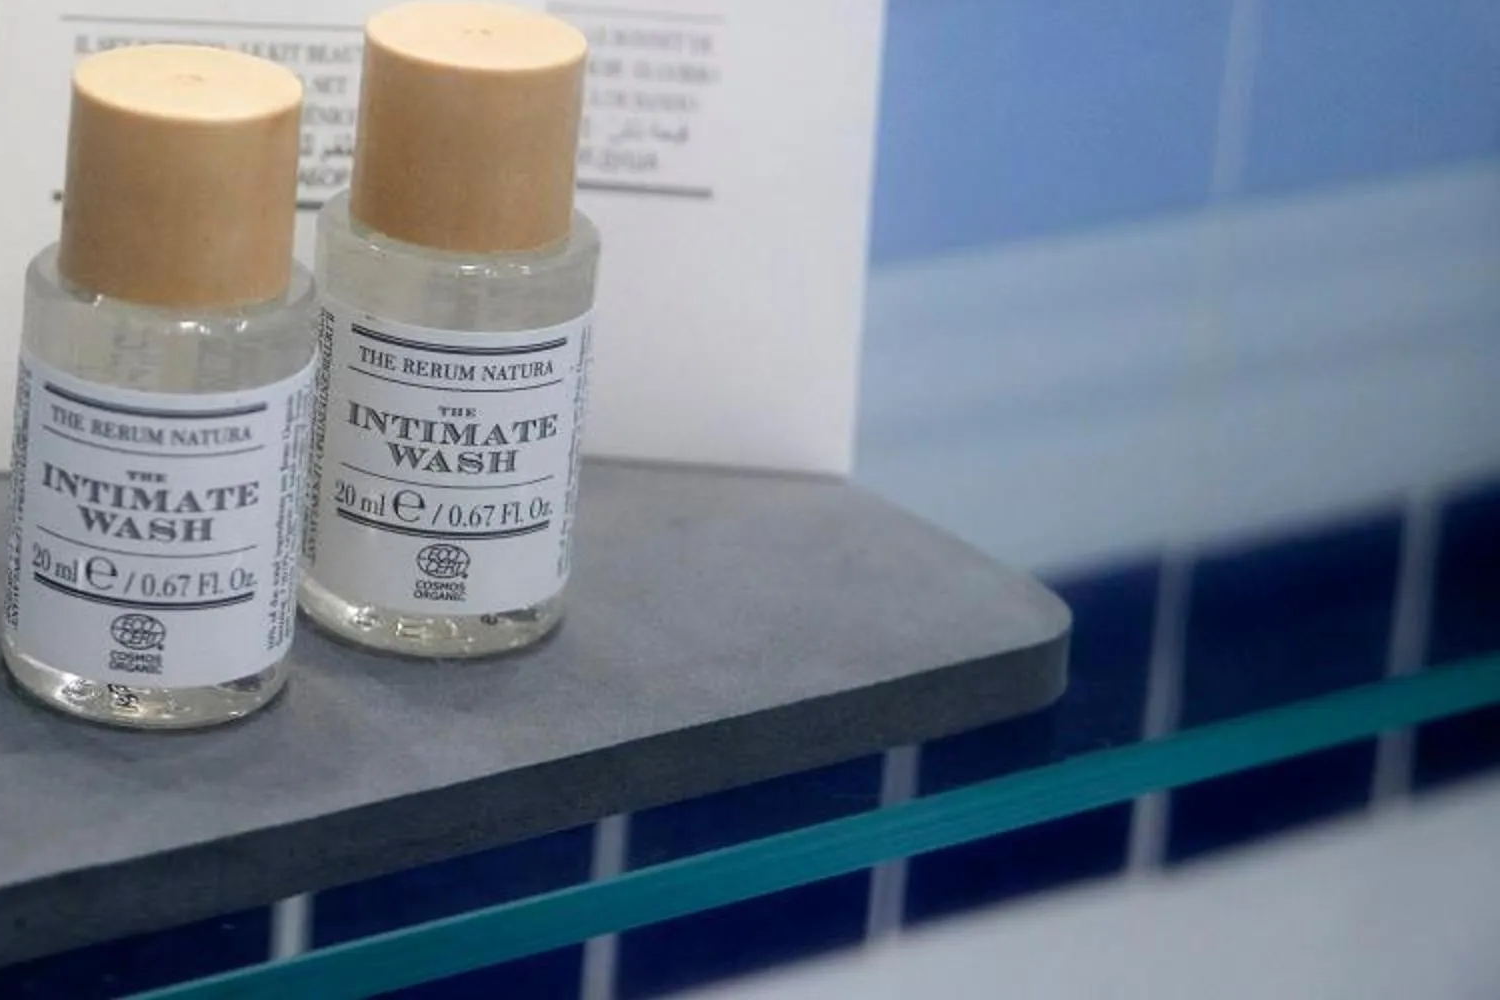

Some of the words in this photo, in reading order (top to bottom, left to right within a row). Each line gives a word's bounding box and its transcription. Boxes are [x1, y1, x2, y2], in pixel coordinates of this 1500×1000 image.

[359, 345, 395, 371] THE
[402, 357, 476, 382] RERUM
[481, 360, 553, 382] NATURA
[51, 404, 84, 432] THE
[91, 417, 166, 447] RERUM
[170, 426, 253, 448] NATURA
[346, 399, 560, 448] INTIMATE
[437, 404, 477, 418] THE
[126, 470, 168, 484] THE
[386, 440, 520, 474] WASH
[41, 461, 260, 514] INTIMATE
[334, 478, 356, 507] 20
[361, 493, 386, 518] ml
[449, 503, 495, 528] 0.67
[77, 504, 216, 543] WASH
[32, 543, 51, 573] 20
[55, 559, 78, 585] ml
[141, 571, 192, 598] 0.67
